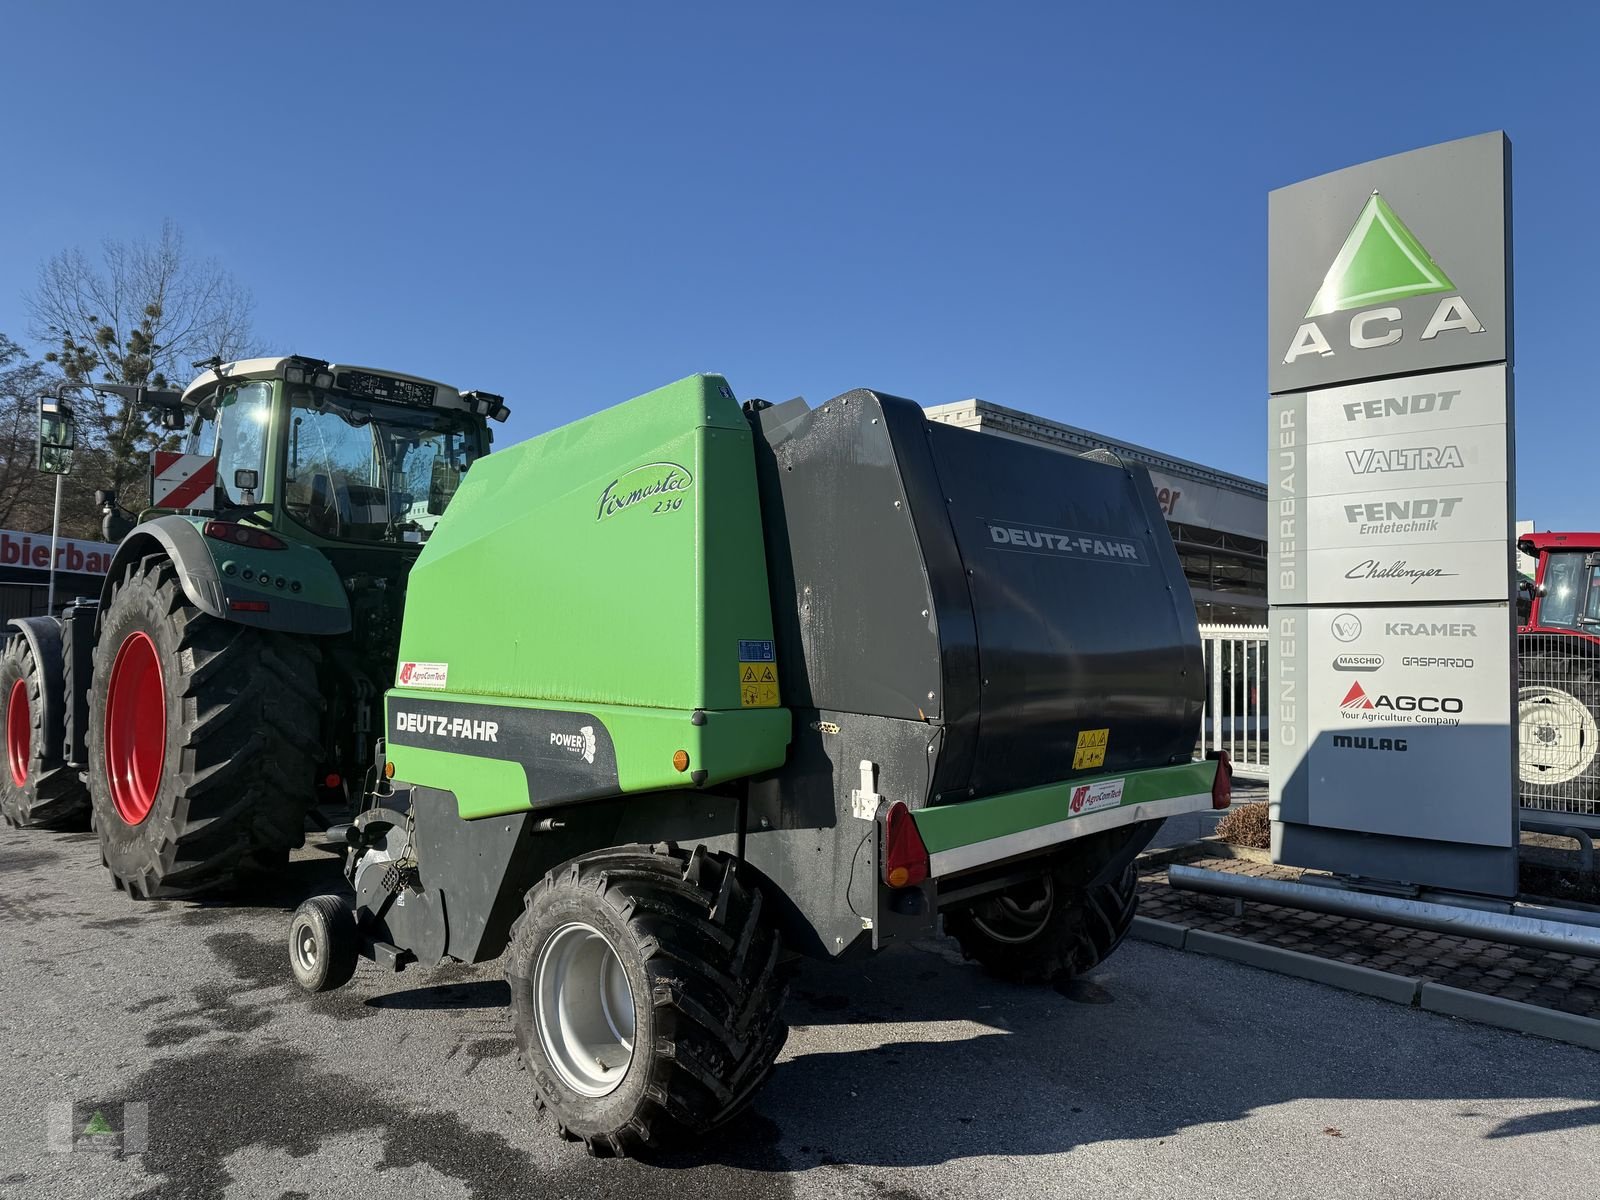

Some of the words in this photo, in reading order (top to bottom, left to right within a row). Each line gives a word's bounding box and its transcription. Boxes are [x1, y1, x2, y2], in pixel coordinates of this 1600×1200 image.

[1282, 296, 1486, 365] ACA
[1343, 390, 1461, 421] FENDT
[1346, 446, 1464, 474] VALTRA
[652, 498, 683, 514] 230
[1280, 408, 1295, 590] BIERBAUER
[1344, 497, 1463, 523] FENDT
[1359, 520, 1438, 535] Erntetechnik
[990, 525, 1138, 560] DEUTZ-FAHR
[1344, 559, 1460, 585] Challenger
[1385, 622, 1478, 637] KRAMER
[1339, 657, 1382, 665] MASCHIO
[1402, 657, 1474, 668] GASPARDO
[1281, 617, 1296, 746] CENTER
[1374, 695, 1463, 713] AGCO
[396, 711, 499, 743] DEUTZ-FAHR
[1340, 711, 1360, 720] Your
[1361, 711, 1413, 723] Agriculture
[1415, 714, 1460, 727] Company
[550, 733, 583, 748] POWER
[1333, 735, 1408, 752] MULAG
